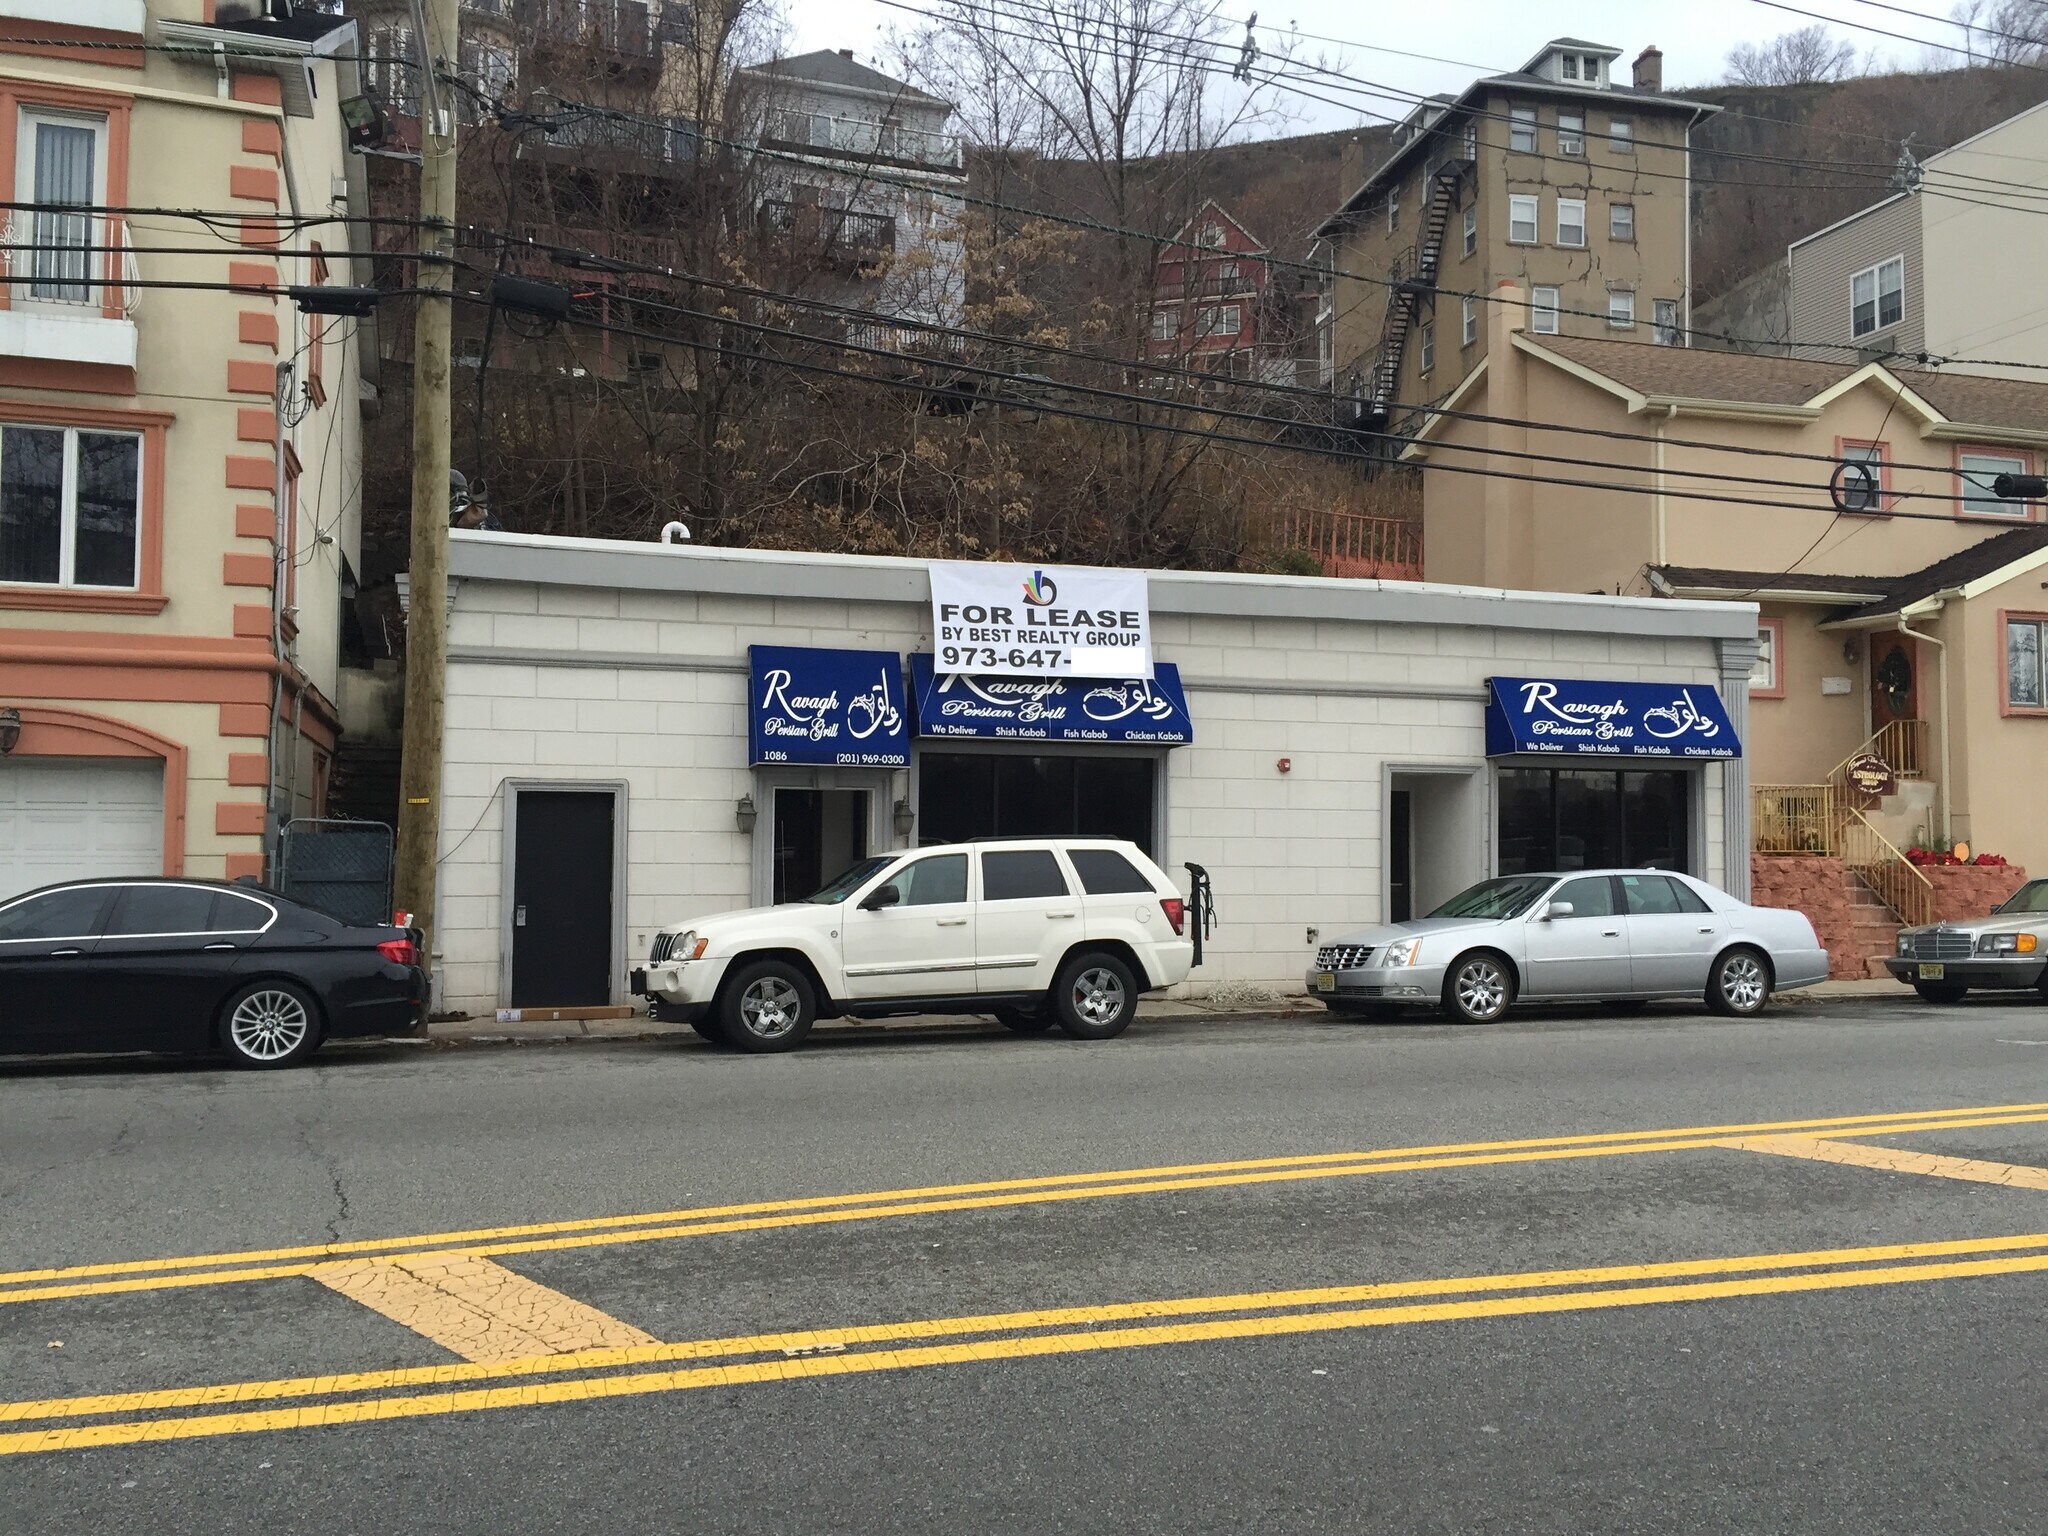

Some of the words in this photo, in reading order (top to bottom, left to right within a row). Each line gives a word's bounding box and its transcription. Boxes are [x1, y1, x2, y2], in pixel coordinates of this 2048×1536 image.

[940, 604, 1014, 625] FOR
[1026, 608, 1140, 629] LEASE
[942, 626, 963, 641] BY
[969, 627, 1012, 643] BEST
[1017, 629, 1081, 645] REALTY
[1086, 632, 1141, 647] GROUP
[763, 669, 839, 721] Ravagh
[1519, 682, 1628, 723] Ravagh
[941, 700, 1015, 719] Persian
[1018, 701, 1067, 722] Grill
[765, 717, 808, 737] Persian
[810, 717, 839, 741] Grill
[932, 725, 947, 735] We
[948, 725, 977, 735] Deliver
[995, 726, 1015, 737] Shish
[1016, 727, 1047, 738] Kabob
[1063, 728, 1080, 739] Fish
[1081, 729, 1108, 739] Kabob
[1532, 720, 1593, 737] Persian
[1595, 721, 1634, 740] Grill
[1125, 731, 1156, 741] Chicken
[1157, 731, 1184, 741] Kabob
[1526, 742, 1539, 751] We
[1540, 742, 1564, 752] Deliver
[1578, 743, 1596, 752] Shish
[1596, 743, 1620, 753] Kabob
[1634, 745, 1648, 754] Fish
[1648, 745, 1671, 755] Kabob
[1684, 746, 1710, 756] Chicken
[1711, 747, 1733, 756] Kabob
[764, 751, 787, 761] 1086
[836, 753, 860, 764] (201)
[862, 754, 905, 764] 969-0300
[1853, 770, 1888, 780] ASTROLOGY
